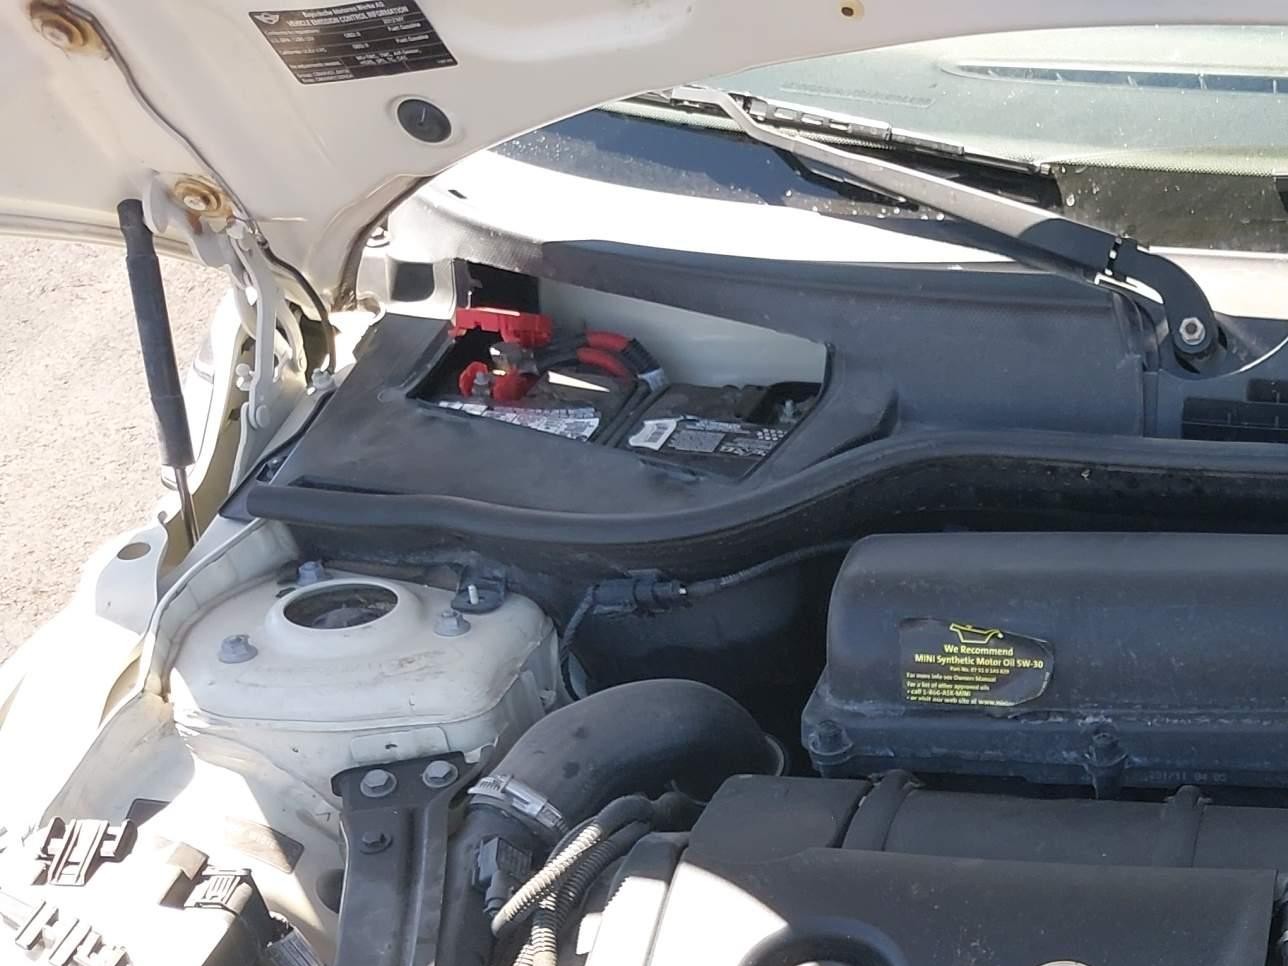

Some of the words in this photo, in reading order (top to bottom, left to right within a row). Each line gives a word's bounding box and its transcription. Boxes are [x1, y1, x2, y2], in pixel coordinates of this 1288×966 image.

[339, 12, 368, 22] CONTROL
[366, 6, 409, 18] INFORMATION
[944, 644, 958, 653] We
[960, 645, 1013, 656] Recommend
[914, 654, 935, 663] MINI
[937, 655, 975, 666] Synthetic
[976, 657, 1001, 667] Motor
[1003, 658, 1015, 667] Oil
[1016, 660, 1044, 669] 5W-30
